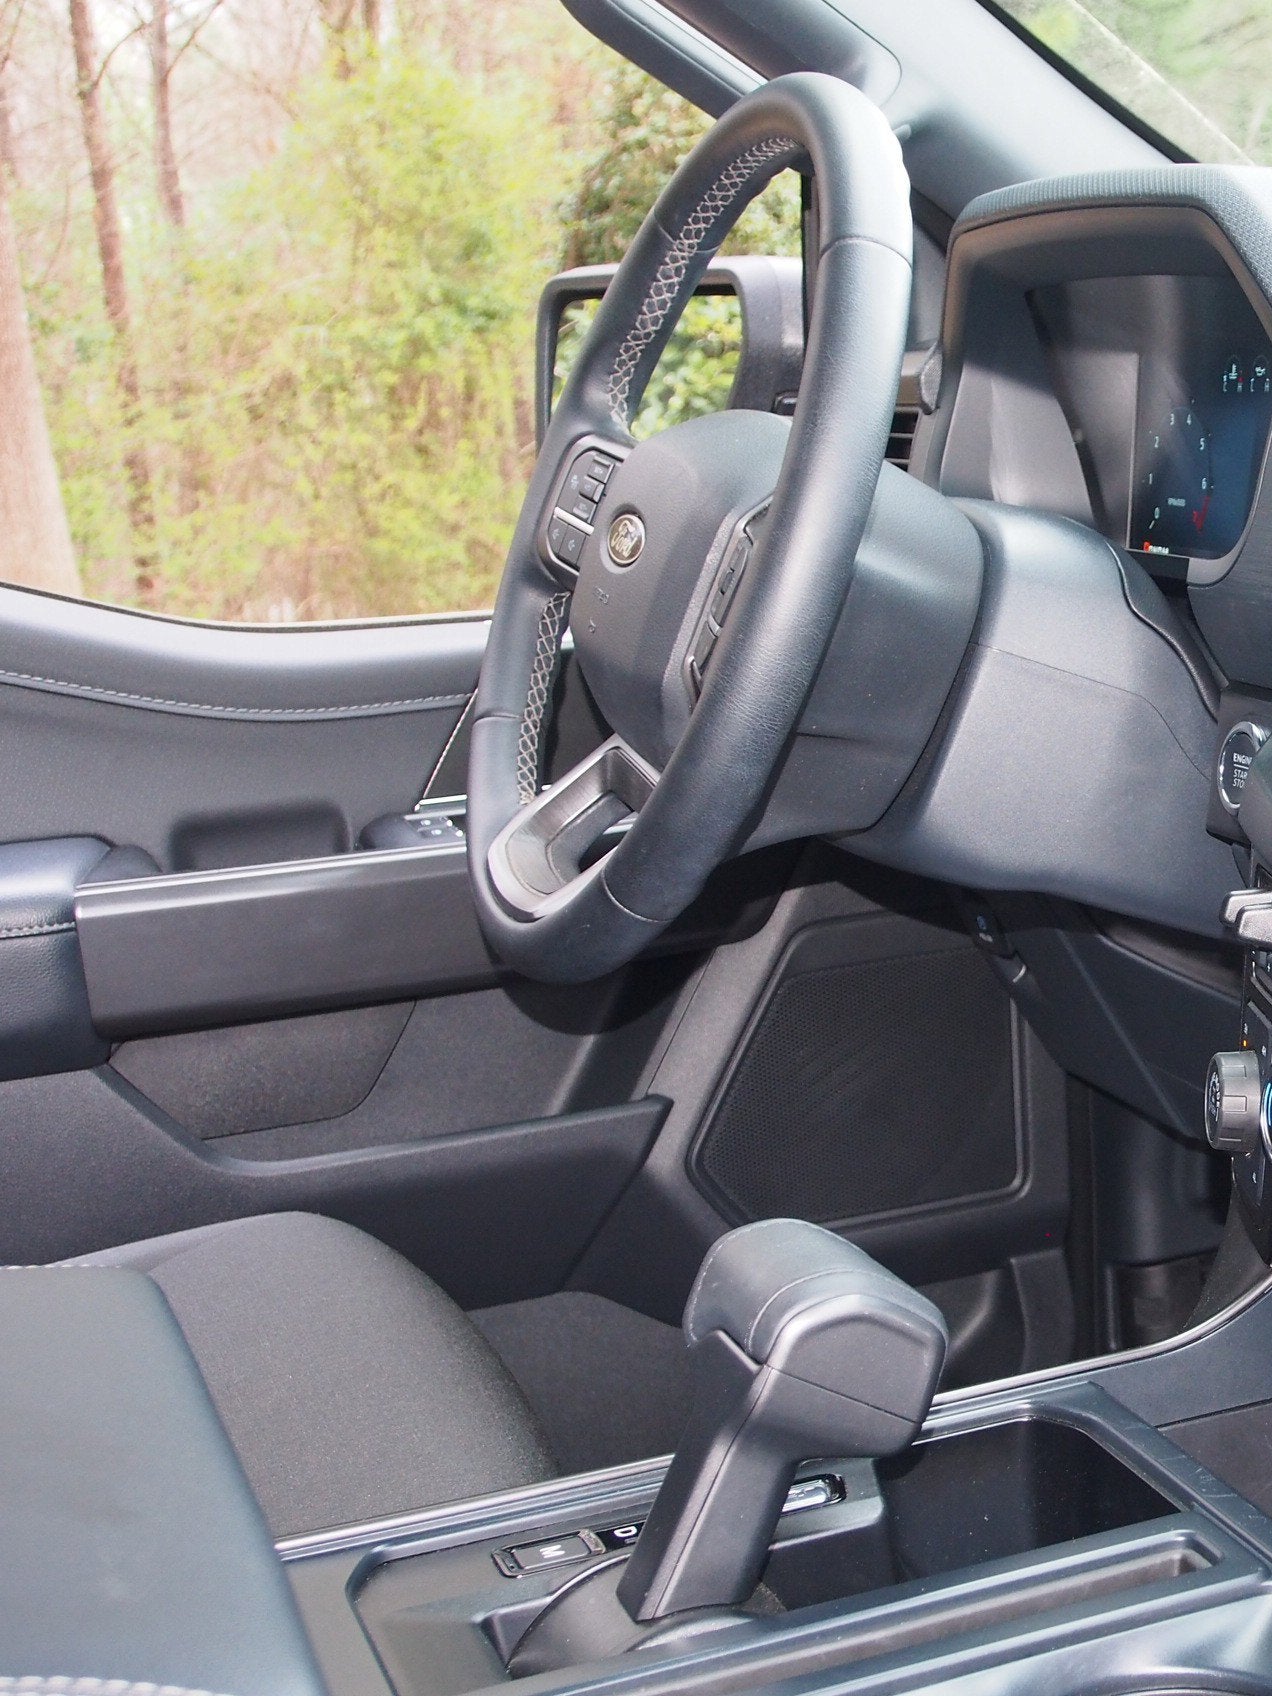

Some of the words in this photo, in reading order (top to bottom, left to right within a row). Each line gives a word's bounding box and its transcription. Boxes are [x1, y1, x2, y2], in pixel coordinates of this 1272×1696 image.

[1186, 414, 1192, 426] 4
[1154, 436, 1159, 448] 2
[1199, 437, 1205, 450] 5
[1202, 477, 1207, 490] 6
[611, 519, 638, 559] Ford
[1233, 753, 1253, 765] ENGIN
[1233, 769, 1248, 780] STAR
[1233, 779, 1245, 788] STO
[614, 1526, 638, 1538] D
[540, 1544, 566, 1559] M
